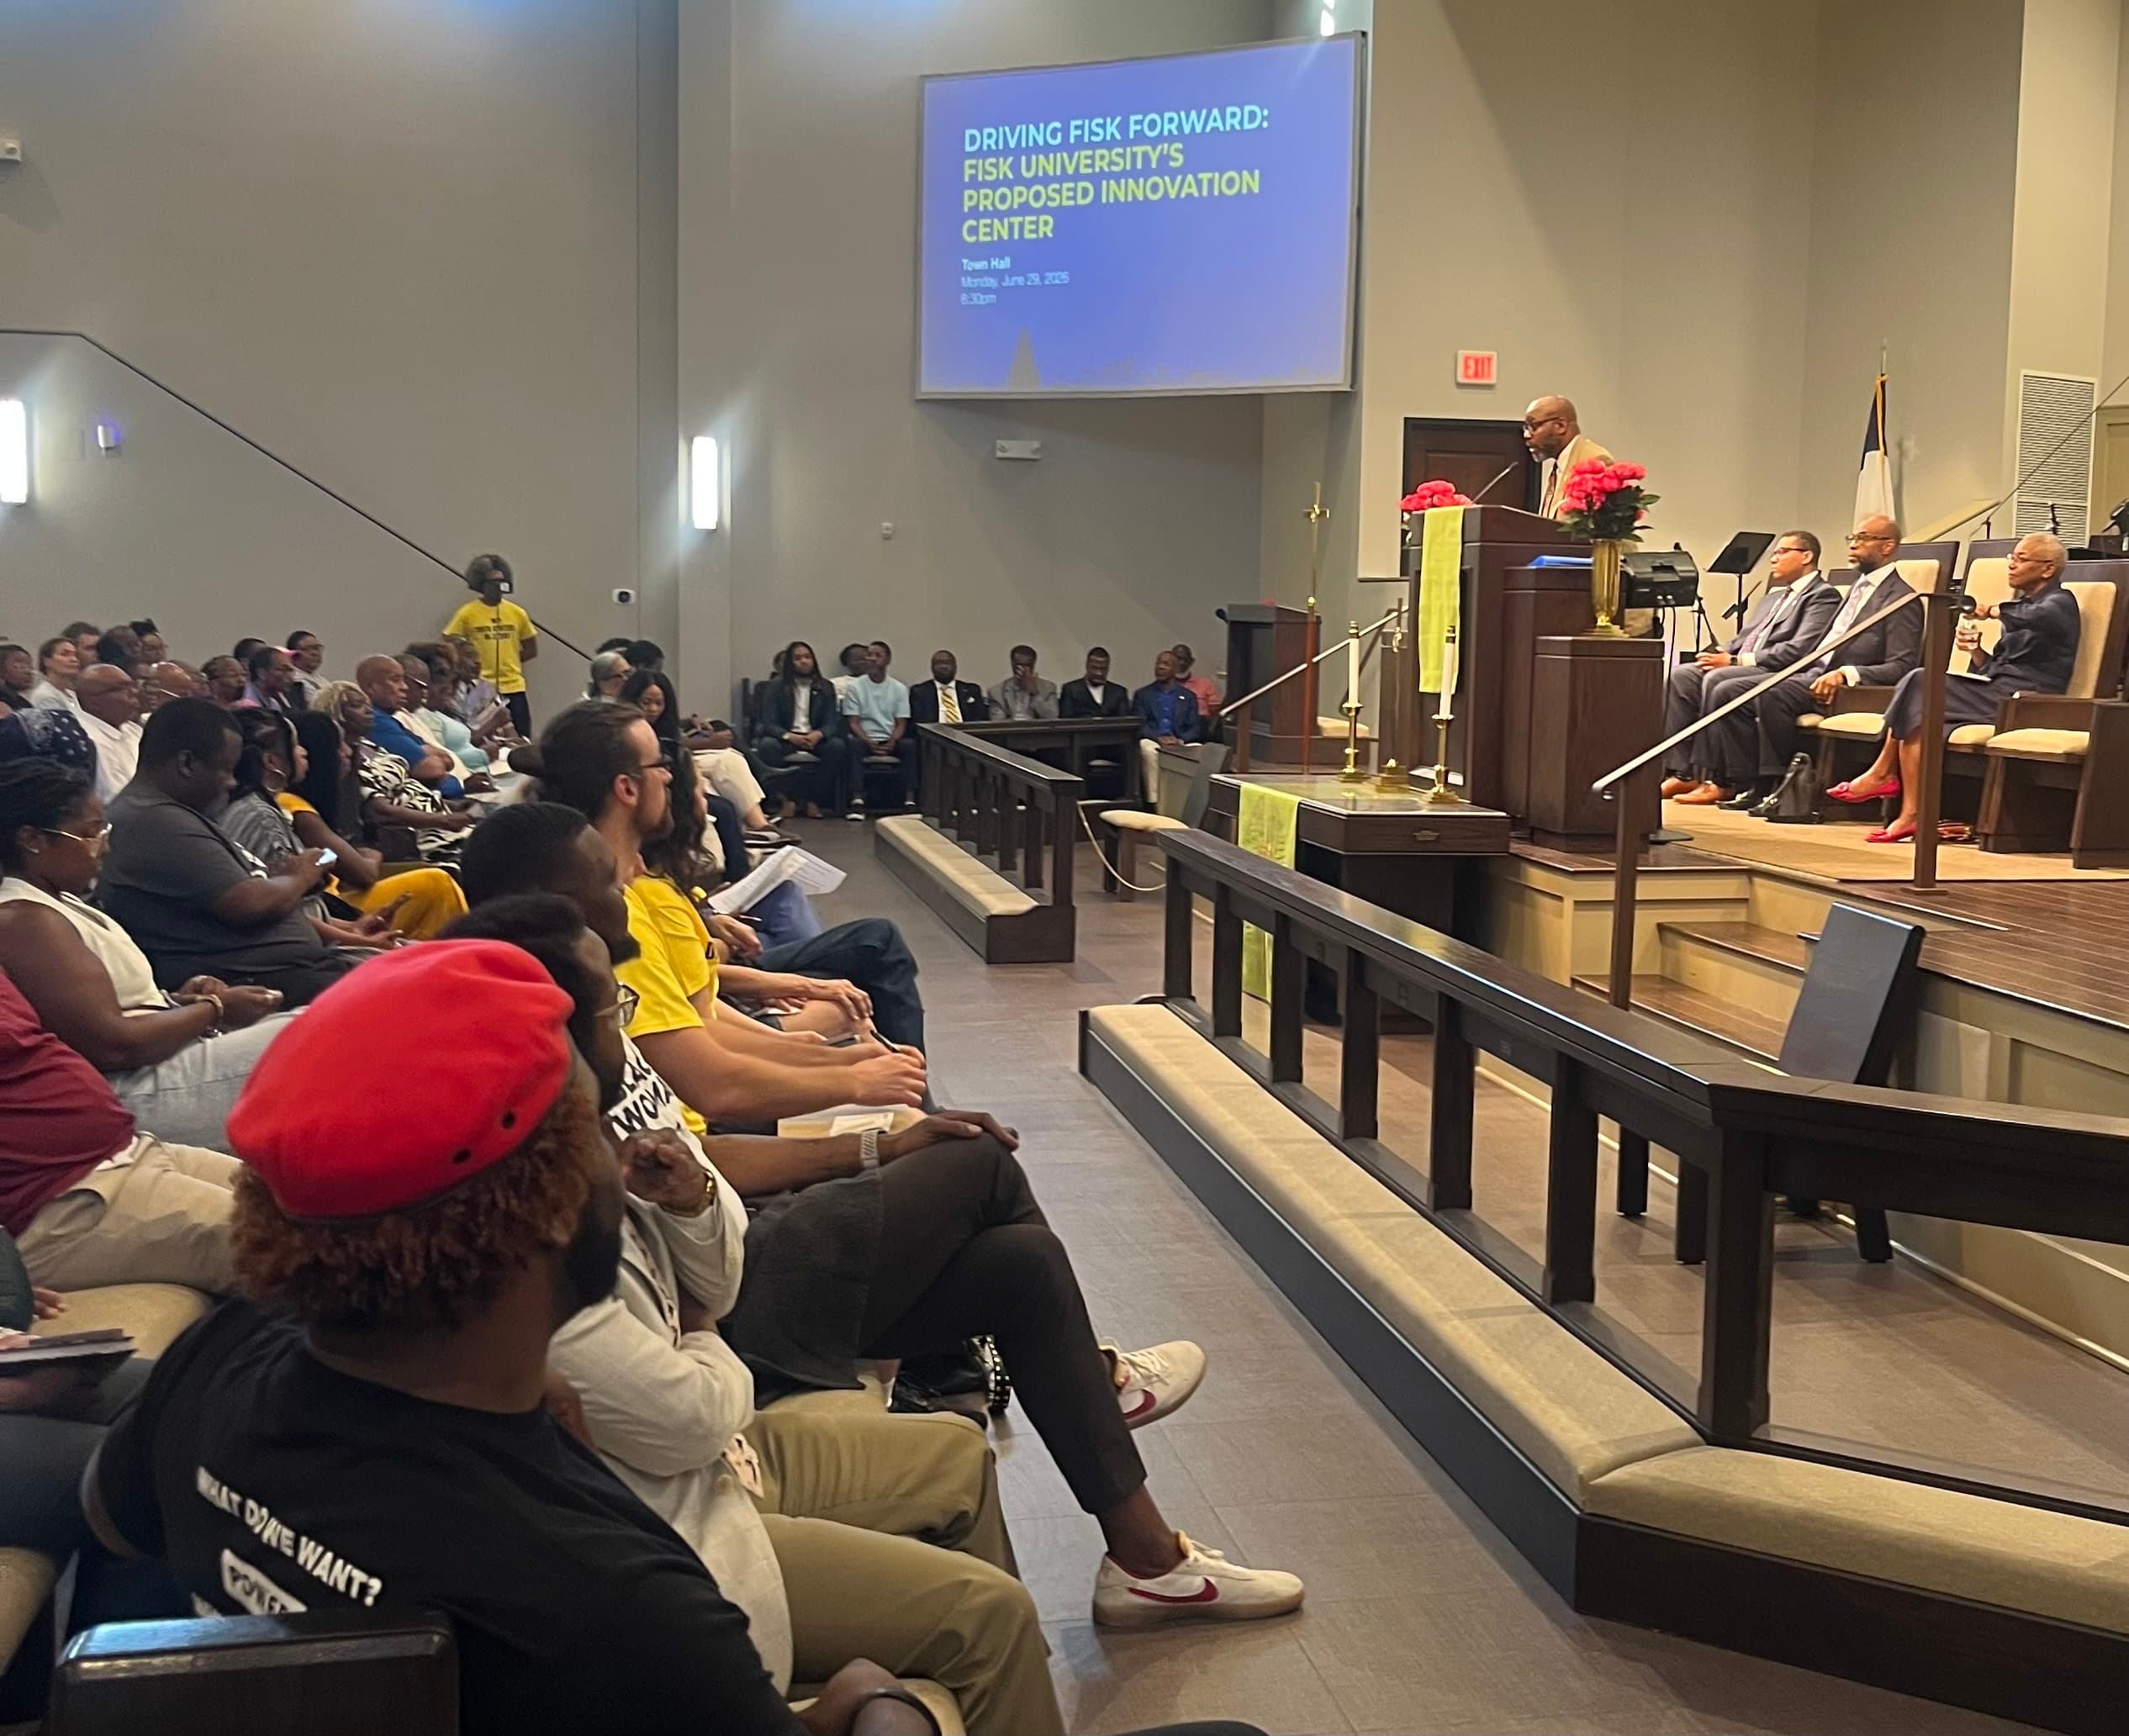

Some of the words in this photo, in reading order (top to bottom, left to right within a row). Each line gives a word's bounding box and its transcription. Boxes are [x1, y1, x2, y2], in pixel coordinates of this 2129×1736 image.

[964, 121, 1062, 152] DRIVING
[1070, 116, 1122, 144] FISK
[1128, 105, 1268, 139] FORWARD:
[964, 156, 1014, 182] FISK
[1021, 142, 1184, 179] UNIVERSITY'S
[963, 181, 1095, 213] PROPOSED
[1101, 169, 1260, 203] INNOVATION
[962, 214, 1054, 244] CENTER
[962, 258, 989, 271] Town
[991, 256, 1011, 269] Hall
[1001, 272, 1026, 287] June
[1464, 356, 1492, 379] EXIT
[297, 1536, 383, 1607] WANT?
